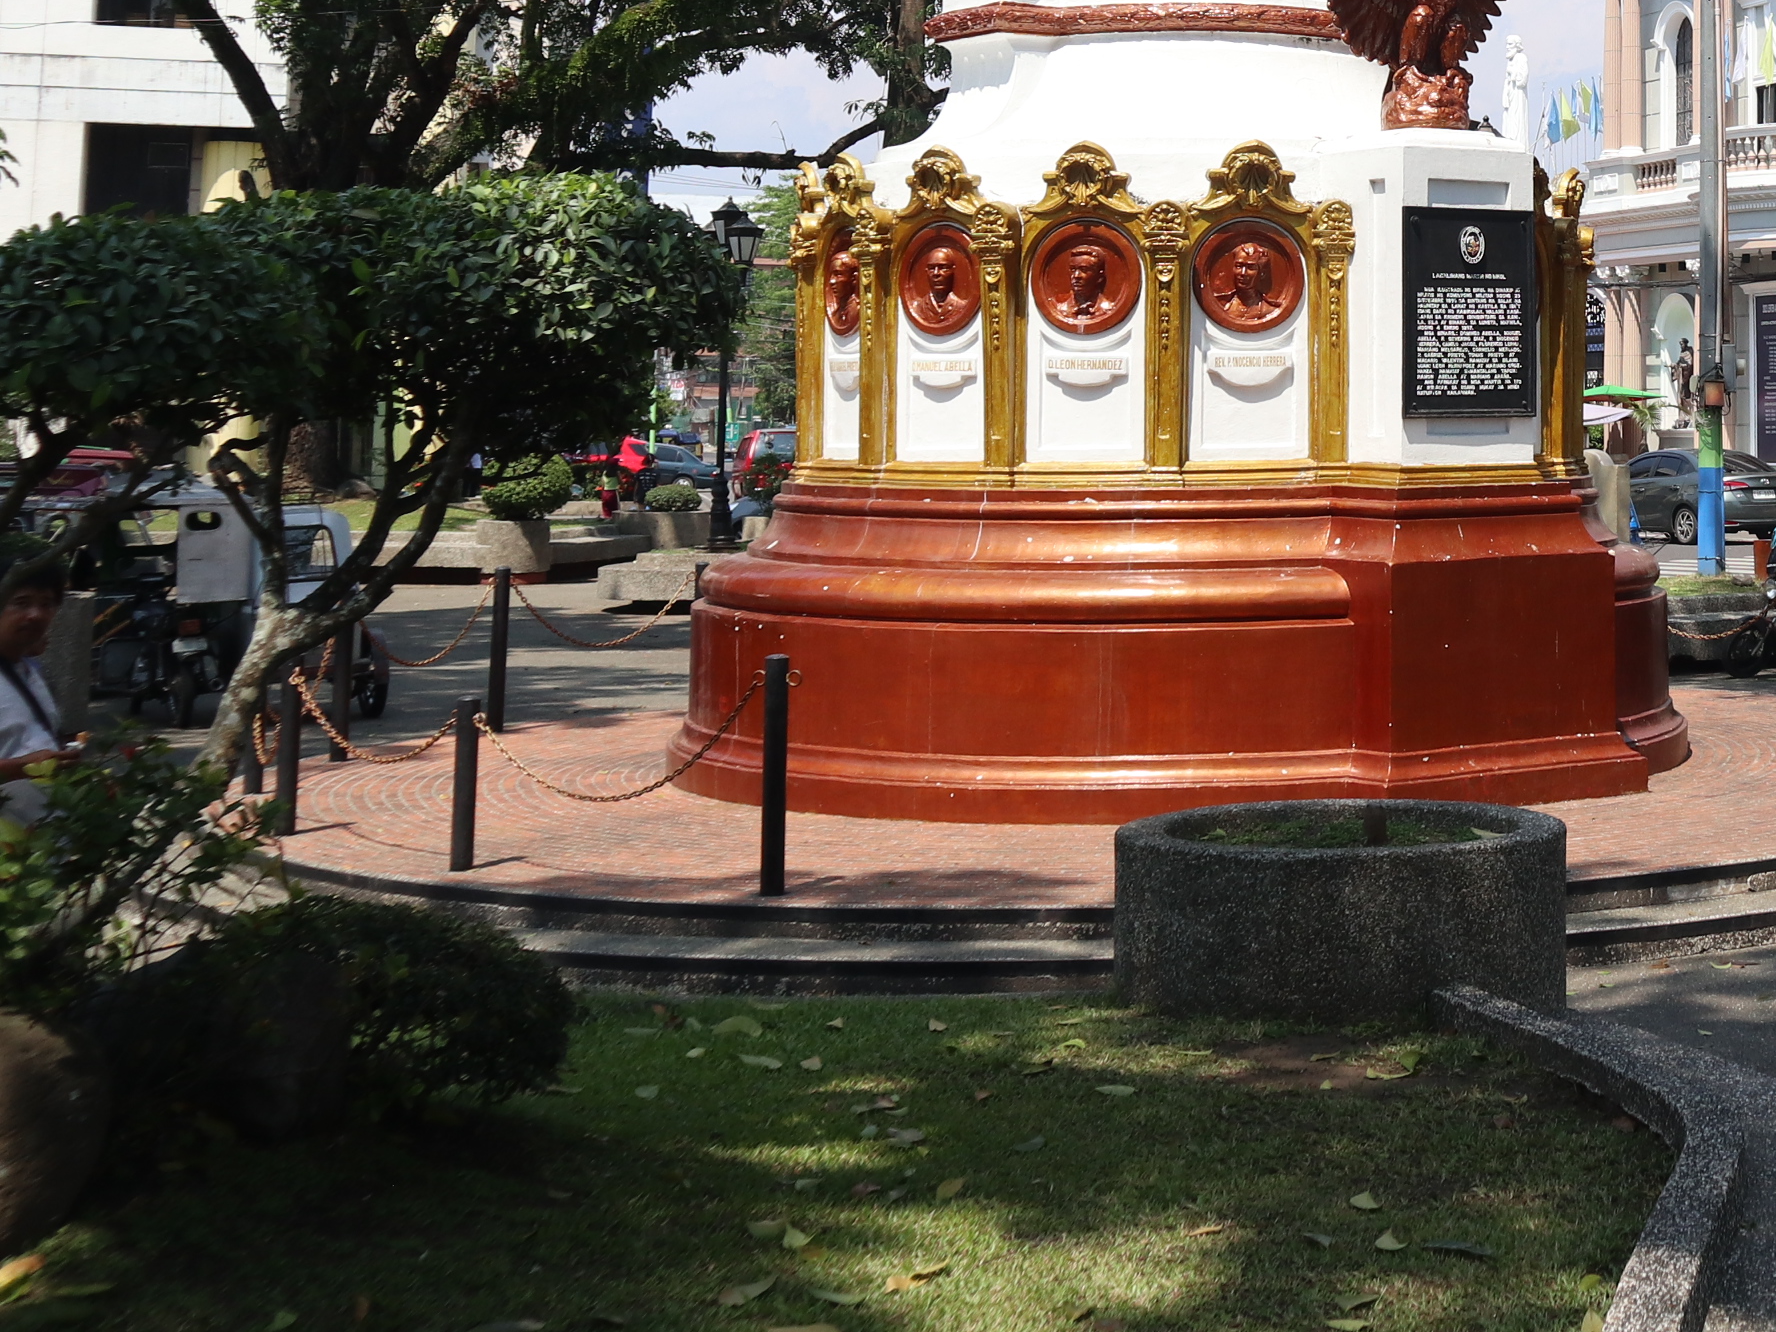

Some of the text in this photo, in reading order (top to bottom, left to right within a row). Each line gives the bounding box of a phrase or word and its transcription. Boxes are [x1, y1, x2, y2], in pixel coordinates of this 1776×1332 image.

[917, 361, 943, 372] MANUEL
[944, 360, 973, 372] ABELLA
[1055, 359, 1076, 369] LEON
[1077, 359, 1123, 370] HERNANDEZ
[1262, 355, 1287, 367] HERRERA
